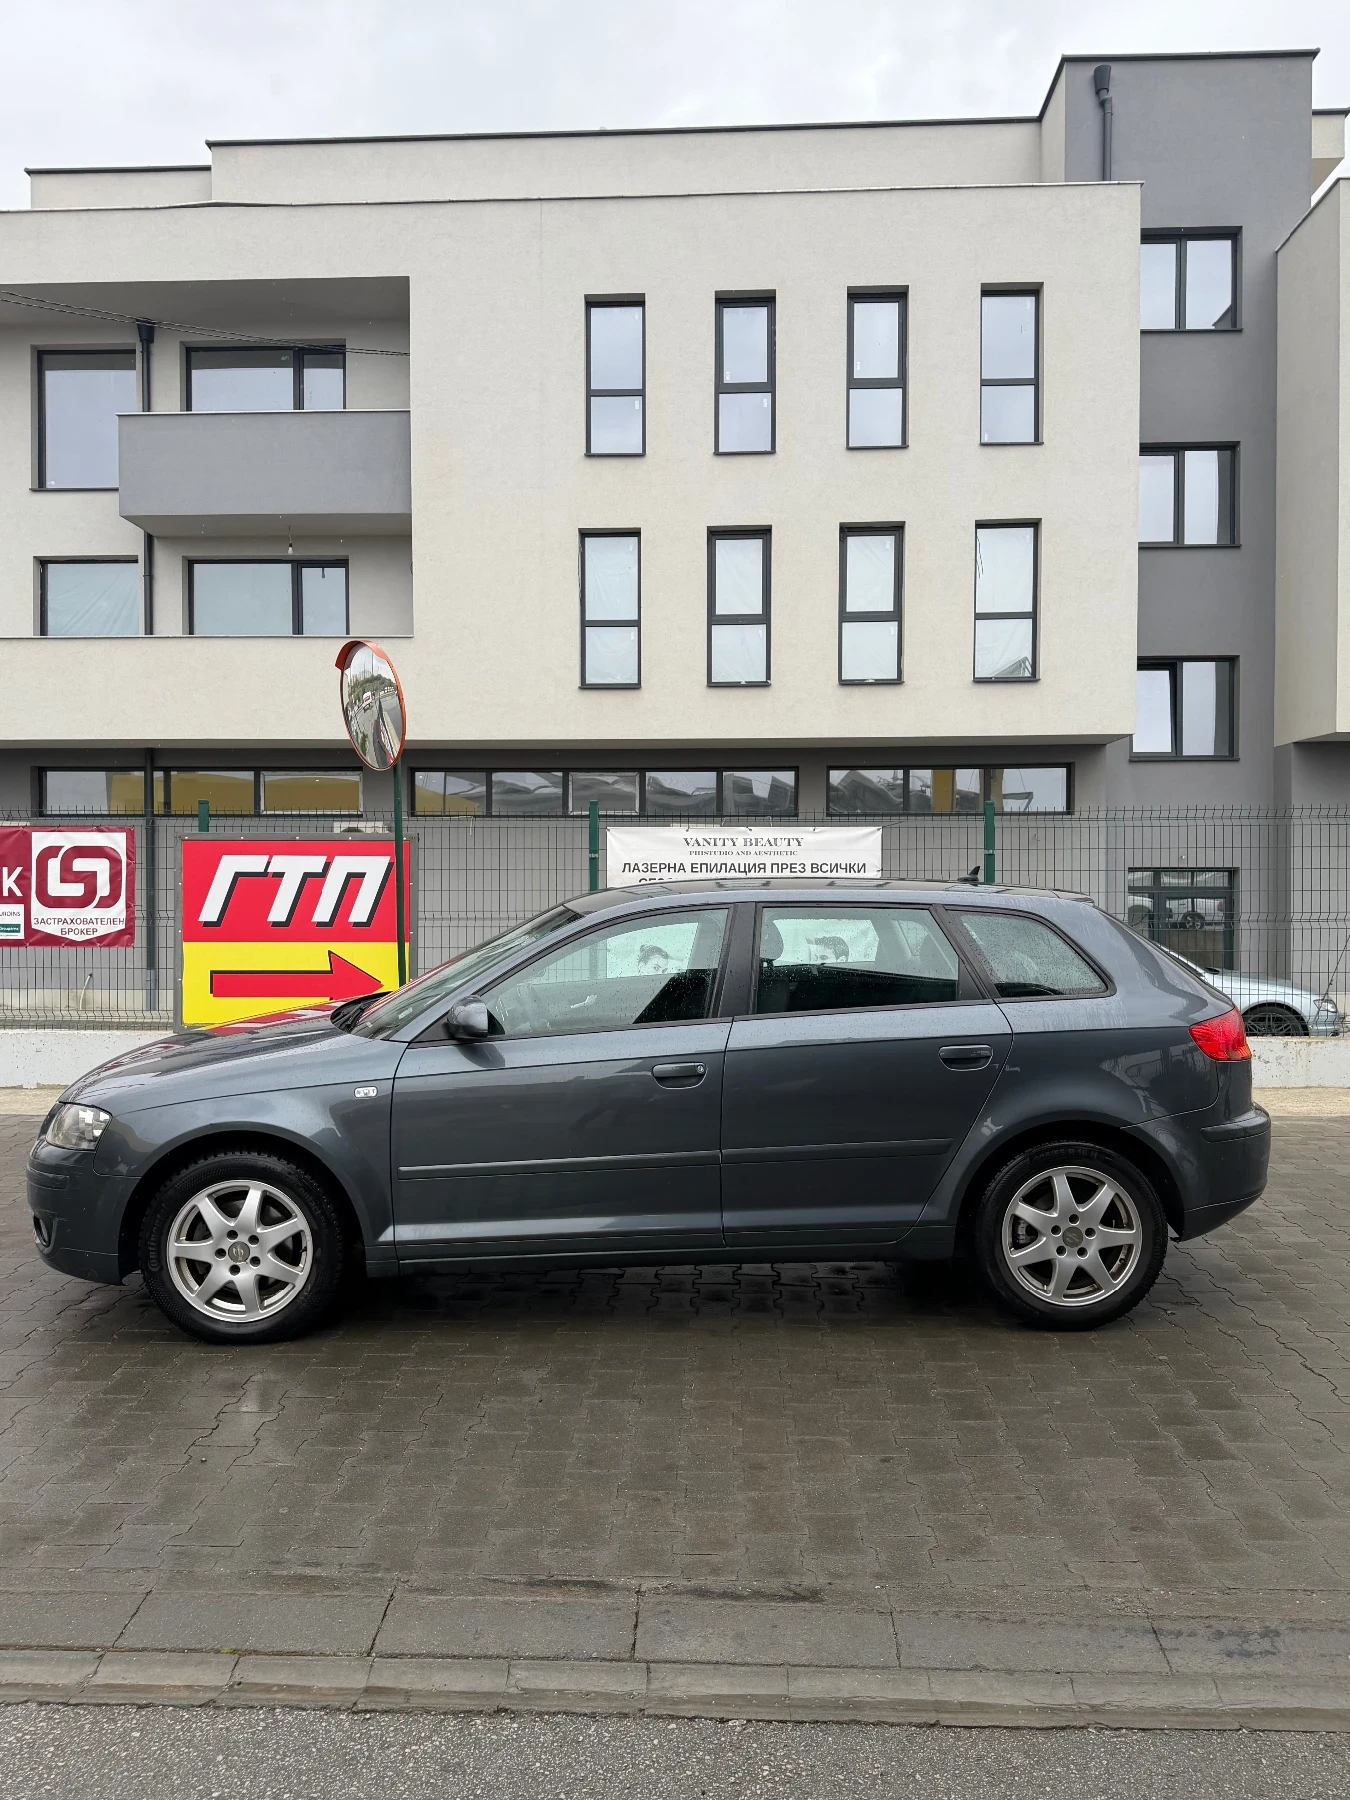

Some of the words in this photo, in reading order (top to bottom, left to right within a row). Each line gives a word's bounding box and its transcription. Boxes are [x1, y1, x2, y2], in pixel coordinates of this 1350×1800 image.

[683, 837, 739, 847] VANITY
[743, 837, 804, 847] BEAUTY
[621, 862, 687, 874] ЛАЗЕРНА
[690, 862, 767, 876] ЕПИЛАЦИЯ
[770, 862, 807, 874] ПРЕЗ
[810, 862, 867, 874] ВСИЧКИ
[198, 855, 393, 925] ГТП
[33, 917, 125, 926] ЗАСТРАХОВАТЕЛЕН
[60, 927, 98, 936] БРОКЕР
